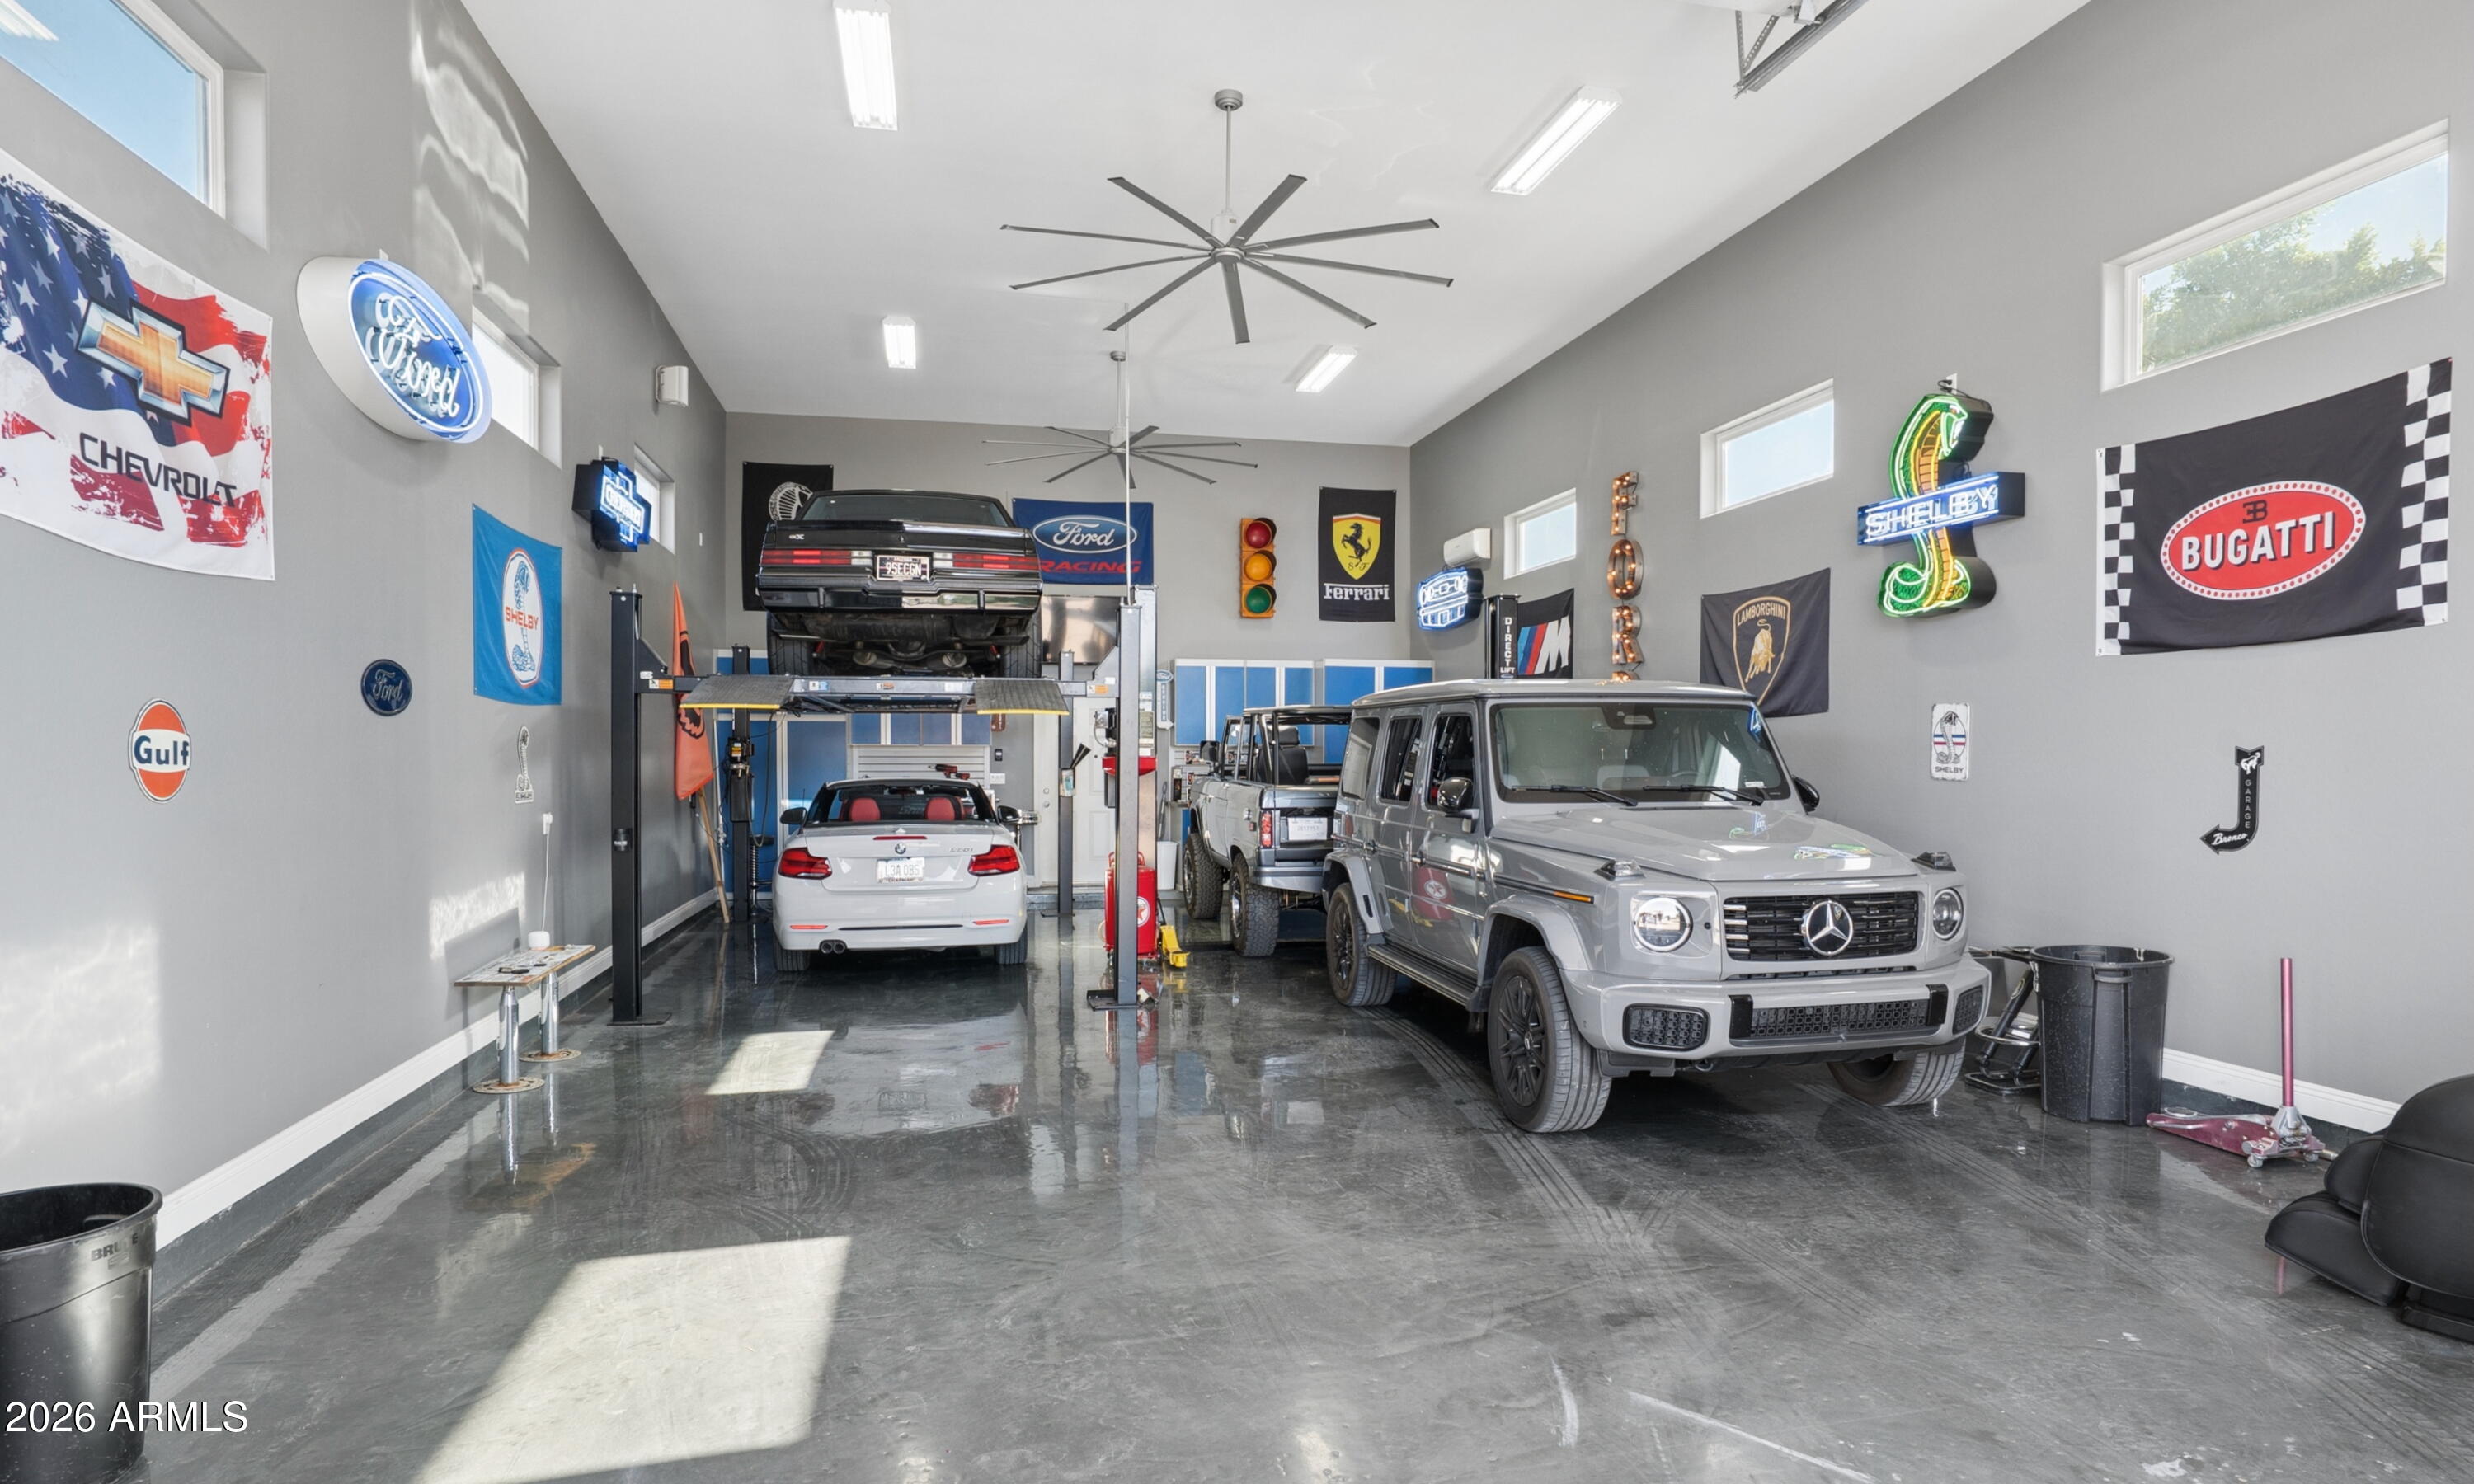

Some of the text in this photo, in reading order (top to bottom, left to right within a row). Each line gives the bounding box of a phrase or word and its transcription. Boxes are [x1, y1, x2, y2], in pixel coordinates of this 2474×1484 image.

[79, 432, 237, 508] CHEVROLET
[1865, 484, 1999, 538] SHELBY
[1053, 521, 1116, 546] Ford
[2181, 511, 2335, 571] BUGATTI
[1040, 560, 1143, 574] RACING
[1608, 470, 1644, 679] FOR
[1323, 582, 1390, 601] Ferrari
[505, 606, 539, 631] SHELBY
[1737, 602, 1786, 627] LAMBORGHINI
[1504, 617, 1512, 667] DIRECT
[373, 669, 403, 702] Ford
[134, 735, 189, 766] Gulf
[2244, 779, 2252, 829] GARAGE
[2211, 832, 2248, 846] Bronco
[91, 1233, 139, 1261] BRUE
